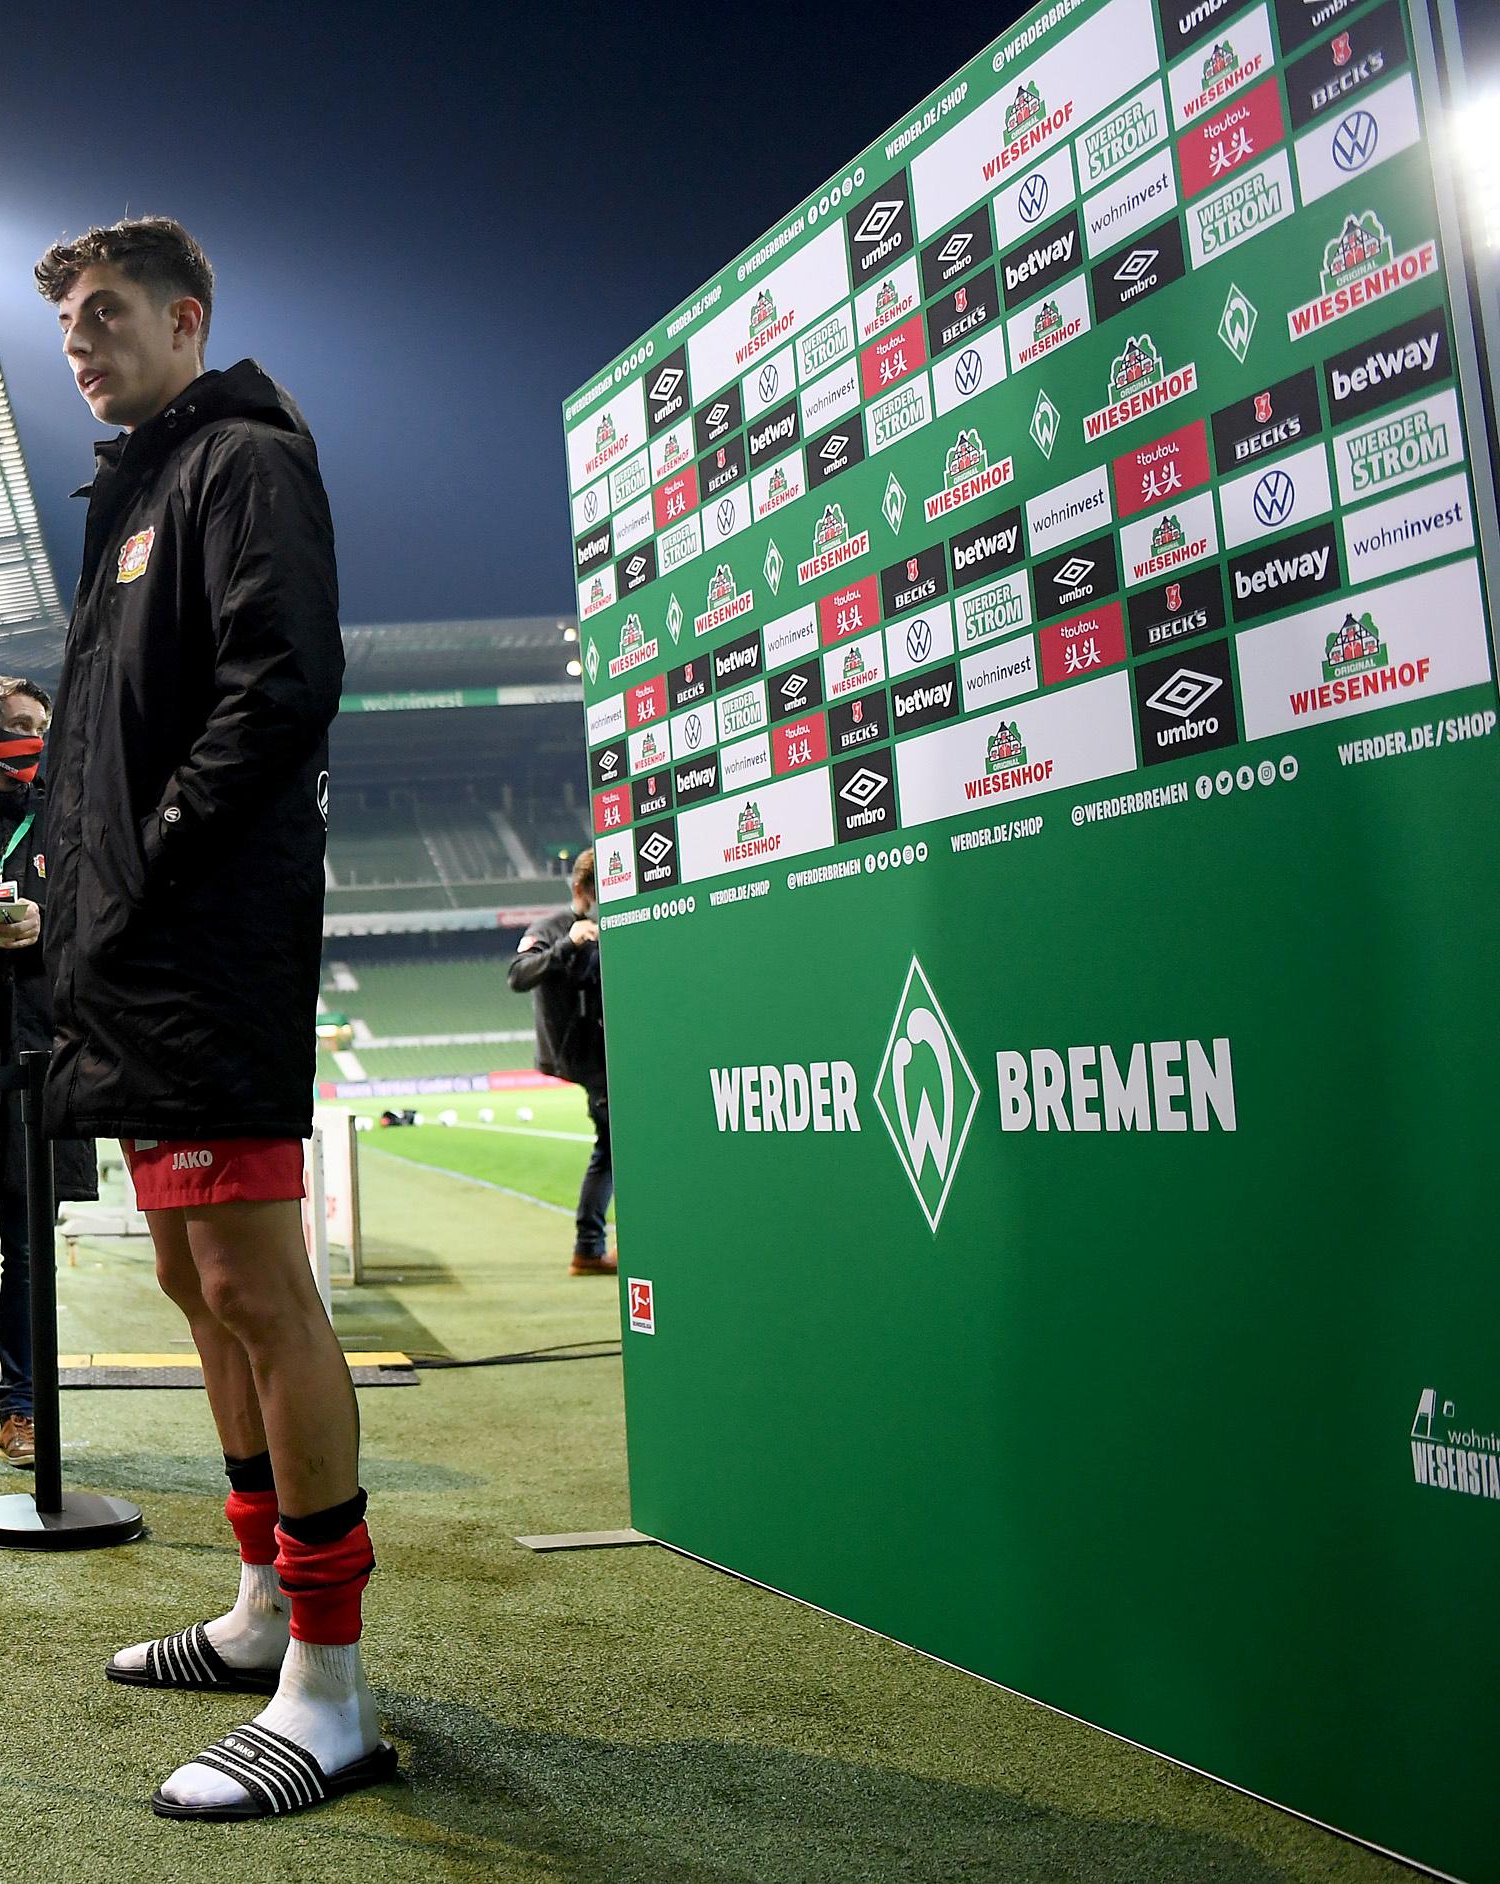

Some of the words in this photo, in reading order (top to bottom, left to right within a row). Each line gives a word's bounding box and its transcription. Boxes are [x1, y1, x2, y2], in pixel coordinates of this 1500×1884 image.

[1183, 54, 1262, 118] WIESENHOF
[1311, 52, 1384, 110] BECK'S
[885, 82, 968, 160] WERDER.DE/SHOP
[1086, 102, 1143, 152] WERDER
[982, 101, 1073, 182] WIESENHOF
[1088, 112, 1157, 180] STROM
[1091, 174, 1169, 234] wohninvest
[1198, 173, 1265, 227] WERDER
[1202, 184, 1280, 253] STROM
[737, 216, 804, 281] @WERDERBREMEN
[861, 232, 901, 270] umbro
[1005, 230, 1074, 291] betway
[943, 254, 971, 279] umbro
[1336, 260, 1378, 286] ORIGINAL
[1120, 274, 1157, 302] umbro
[1292, 246, 1432, 334] WIESENHOF
[864, 296, 912, 336] WIESENHOF
[942, 305, 987, 344] BECK'S
[735, 311, 795, 364] WIESENHOF
[802, 319, 839, 353] WERDER
[805, 332, 848, 374] STROM
[1019, 319, 1081, 364] WIESENHOF
[1331, 332, 1439, 400] betway
[806, 379, 854, 418] wohninvest
[872, 388, 913, 421] WERDER
[1086, 369, 1193, 440] WIESENHOF
[1120, 377, 1152, 398] ORIGINAL
[654, 396, 682, 424] umbro
[875, 398, 924, 444] STROM
[709, 421, 728, 439] umbro
[750, 413, 796, 454] betway
[1235, 417, 1300, 461] BECK'S
[1348, 411, 1429, 458] WERDER
[585, 434, 628, 474] WIESENHOF
[656, 449, 688, 477] WIESENHOF
[824, 455, 847, 474] umbro
[1352, 424, 1448, 491] STROM
[614, 461, 639, 490] WERDER
[616, 472, 645, 503] STROM
[709, 464, 738, 492] BECK'S
[927, 462, 1011, 518] WIESENHOF
[759, 484, 799, 514] WIESENHOF
[1032, 489, 1105, 533] wohninvest
[616, 512, 650, 538] wohninvest
[662, 525, 689, 550] WERDER
[1354, 503, 1462, 556] wohninvest
[578, 533, 609, 564] betway
[663, 534, 697, 568] STROM
[799, 537, 867, 581] WIESENHOF
[954, 526, 1018, 569] betway
[1133, 539, 1207, 578] WIESENHOF
[1235, 546, 1329, 599] betway
[895, 580, 936, 608] BECK'S
[964, 583, 1011, 616] WERDER
[1059, 584, 1093, 604] umbro
[696, 596, 751, 633] WIESENHOF
[967, 595, 1022, 641] STROM
[1149, 609, 1207, 644] BECK'S
[768, 622, 814, 652] wohninvest
[610, 642, 657, 676] WIESENHOF
[716, 644, 758, 676] betway
[967, 657, 1031, 692] wohninvest
[1334, 659, 1376, 677] ORIGINAL
[678, 682, 704, 703] BECK'S
[832, 668, 878, 694] WIESENHOF
[1290, 658, 1430, 715] WIESENHOF
[723, 692, 753, 714] WERDER
[724, 700, 761, 734] STROM
[784, 696, 806, 711] umbro
[895, 682, 953, 718] betway
[591, 709, 622, 730] wohninvest
[841, 723, 879, 748] BECK'S
[1157, 717, 1219, 747] umbro
[1338, 710, 1496, 766] WERDER.DE/SHOP
[635, 751, 666, 771] WIESENHOF
[724, 751, 767, 775] wohninvest
[677, 766, 716, 793] betway
[965, 760, 1053, 800] WIESENHOF
[641, 796, 666, 814] BECK'S
[846, 807, 885, 830] umbro
[1071, 782, 1188, 826] @WERDERBREMEN
[723, 835, 781, 863] WIESENHOF
[951, 816, 1043, 852] WERDER.DE/SHOP
[602, 872, 631, 888] WIESENHOF
[644, 864, 671, 882] umbro
[788, 858, 861, 889] @WERDERBREMEN
[710, 880, 770, 906] WERDER.DE/SHOP
[710, 1061, 860, 1132] WERDER
[997, 1038, 1237, 1132] BREMEN
[172, 1149, 213, 1170] JAKO
[1411, 1440, 1500, 1500] WESERSTA
[233, 1743, 255, 1758] JAKO
